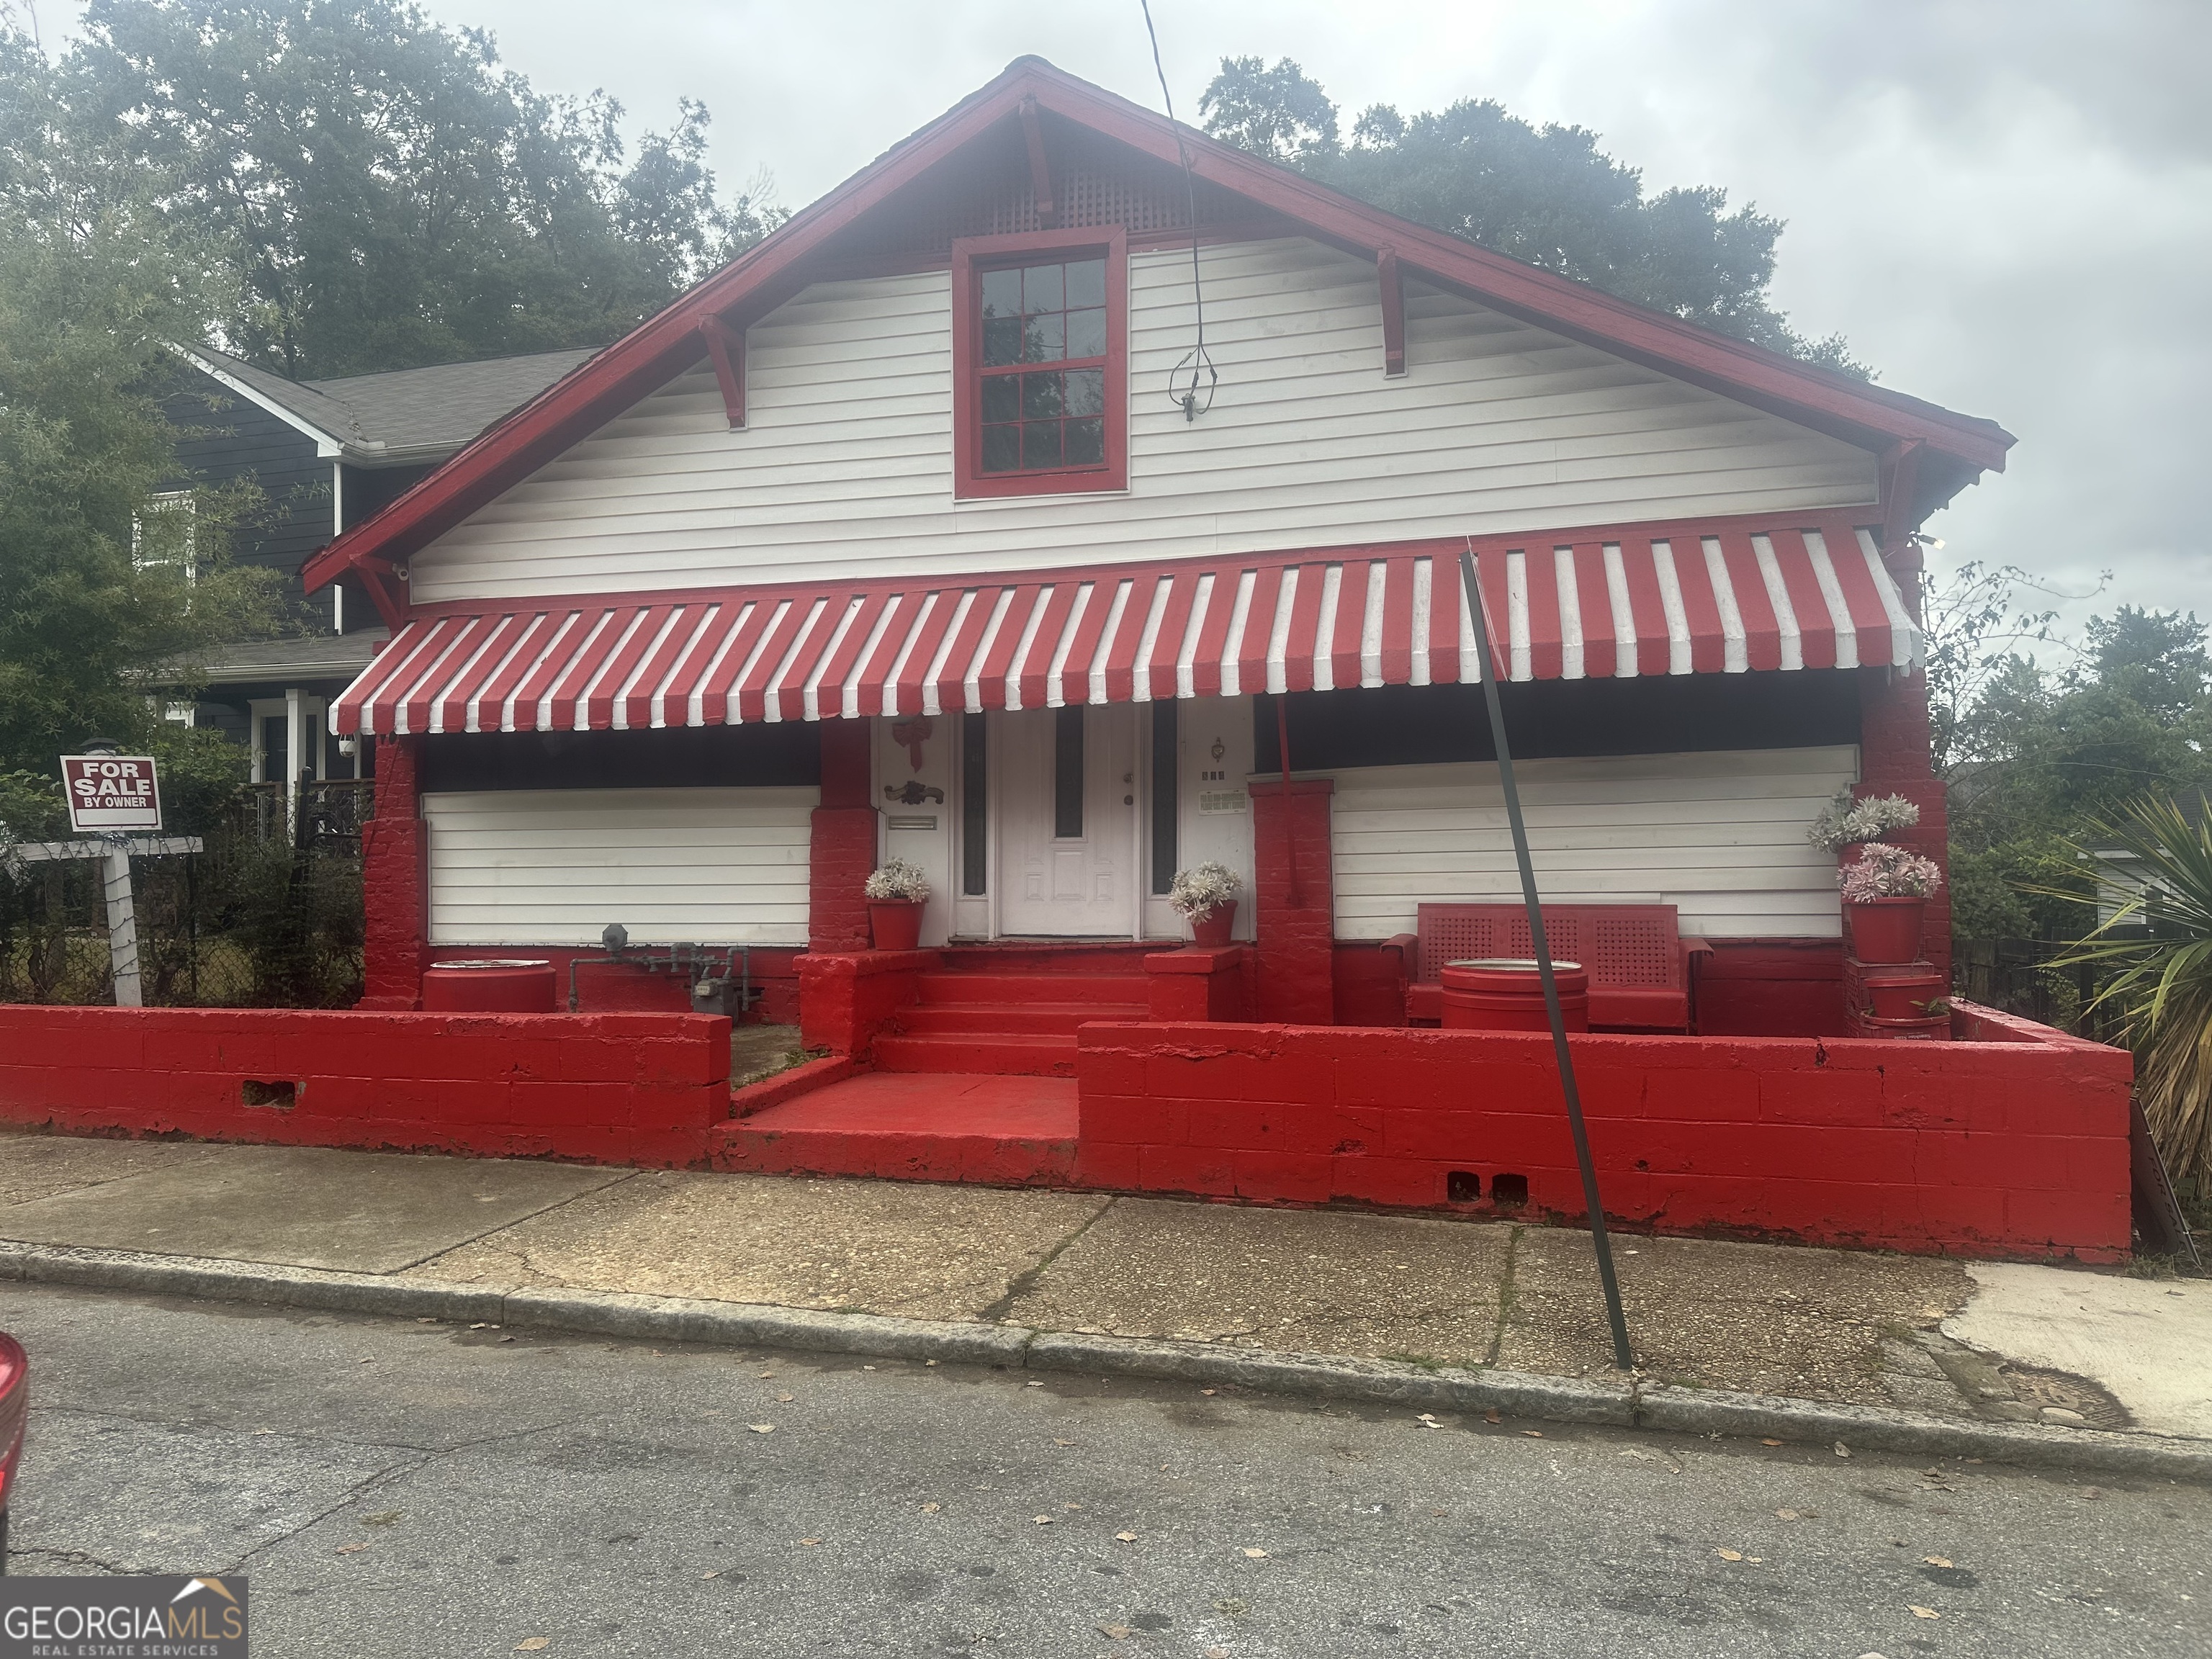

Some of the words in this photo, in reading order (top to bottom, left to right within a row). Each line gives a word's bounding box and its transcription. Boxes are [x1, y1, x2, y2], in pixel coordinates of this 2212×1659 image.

[82, 762, 139, 778] FOR
[74, 778, 152, 796] SALE
[84, 797, 101, 808] BY
[105, 796, 147, 807] OWNER
[2148, 1157, 2166, 1196] FOR
